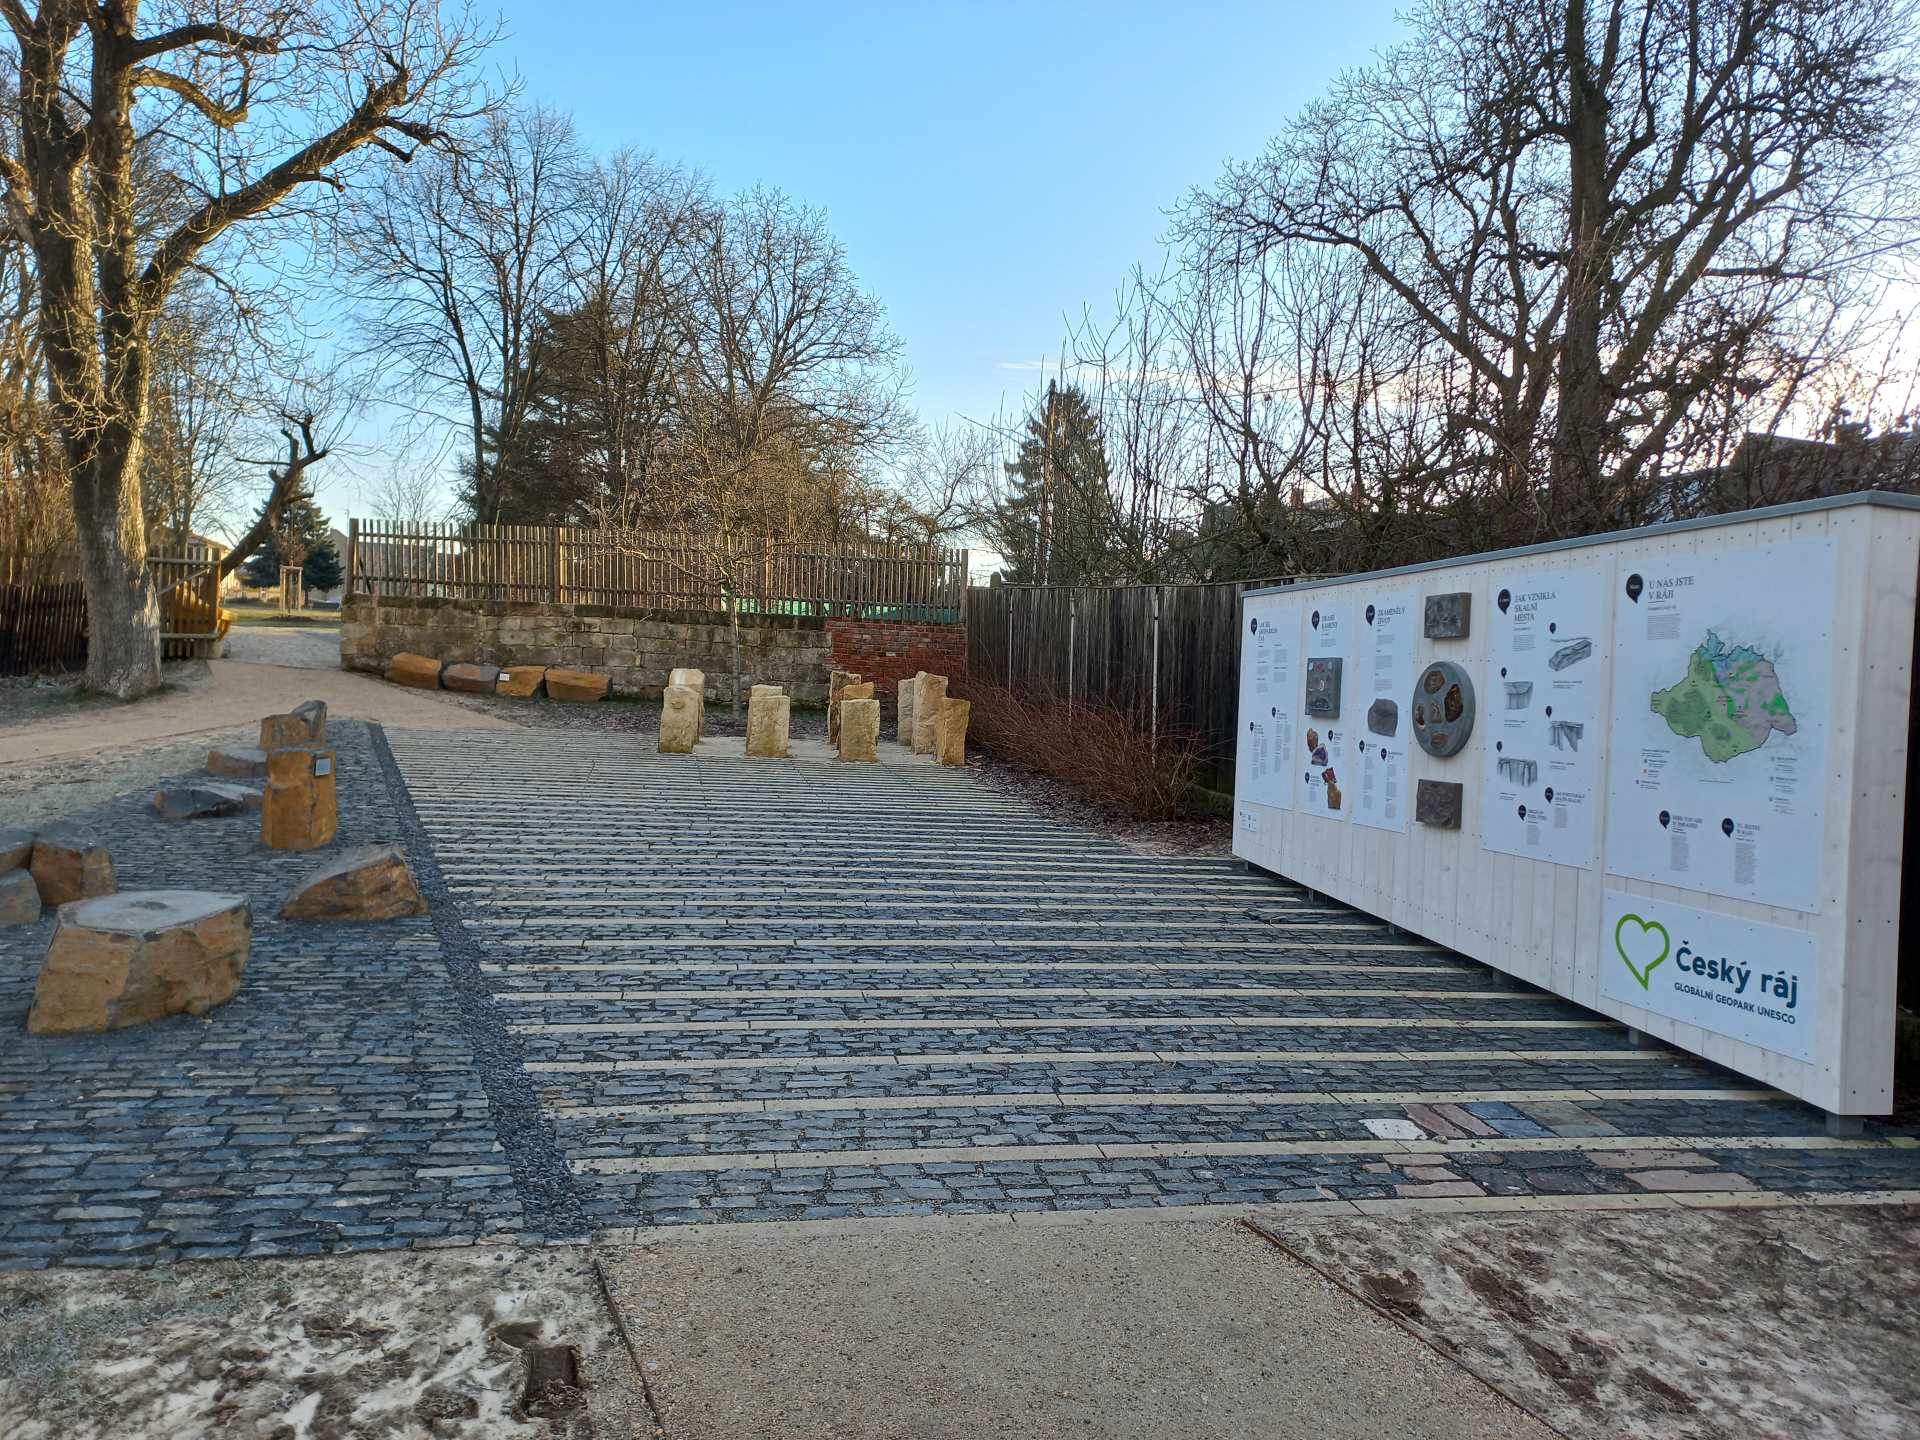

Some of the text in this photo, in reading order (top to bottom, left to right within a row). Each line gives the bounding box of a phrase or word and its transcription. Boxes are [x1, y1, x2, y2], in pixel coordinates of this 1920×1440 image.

[1649, 580, 1655, 589] U
[1675, 576, 1694, 586] JSTE
[1649, 591, 1655, 600] V
[1676, 940, 1797, 1009] Český ráj
[1674, 982, 1796, 1024] GLOBÁLNÍ GEOPARK UNESCO
